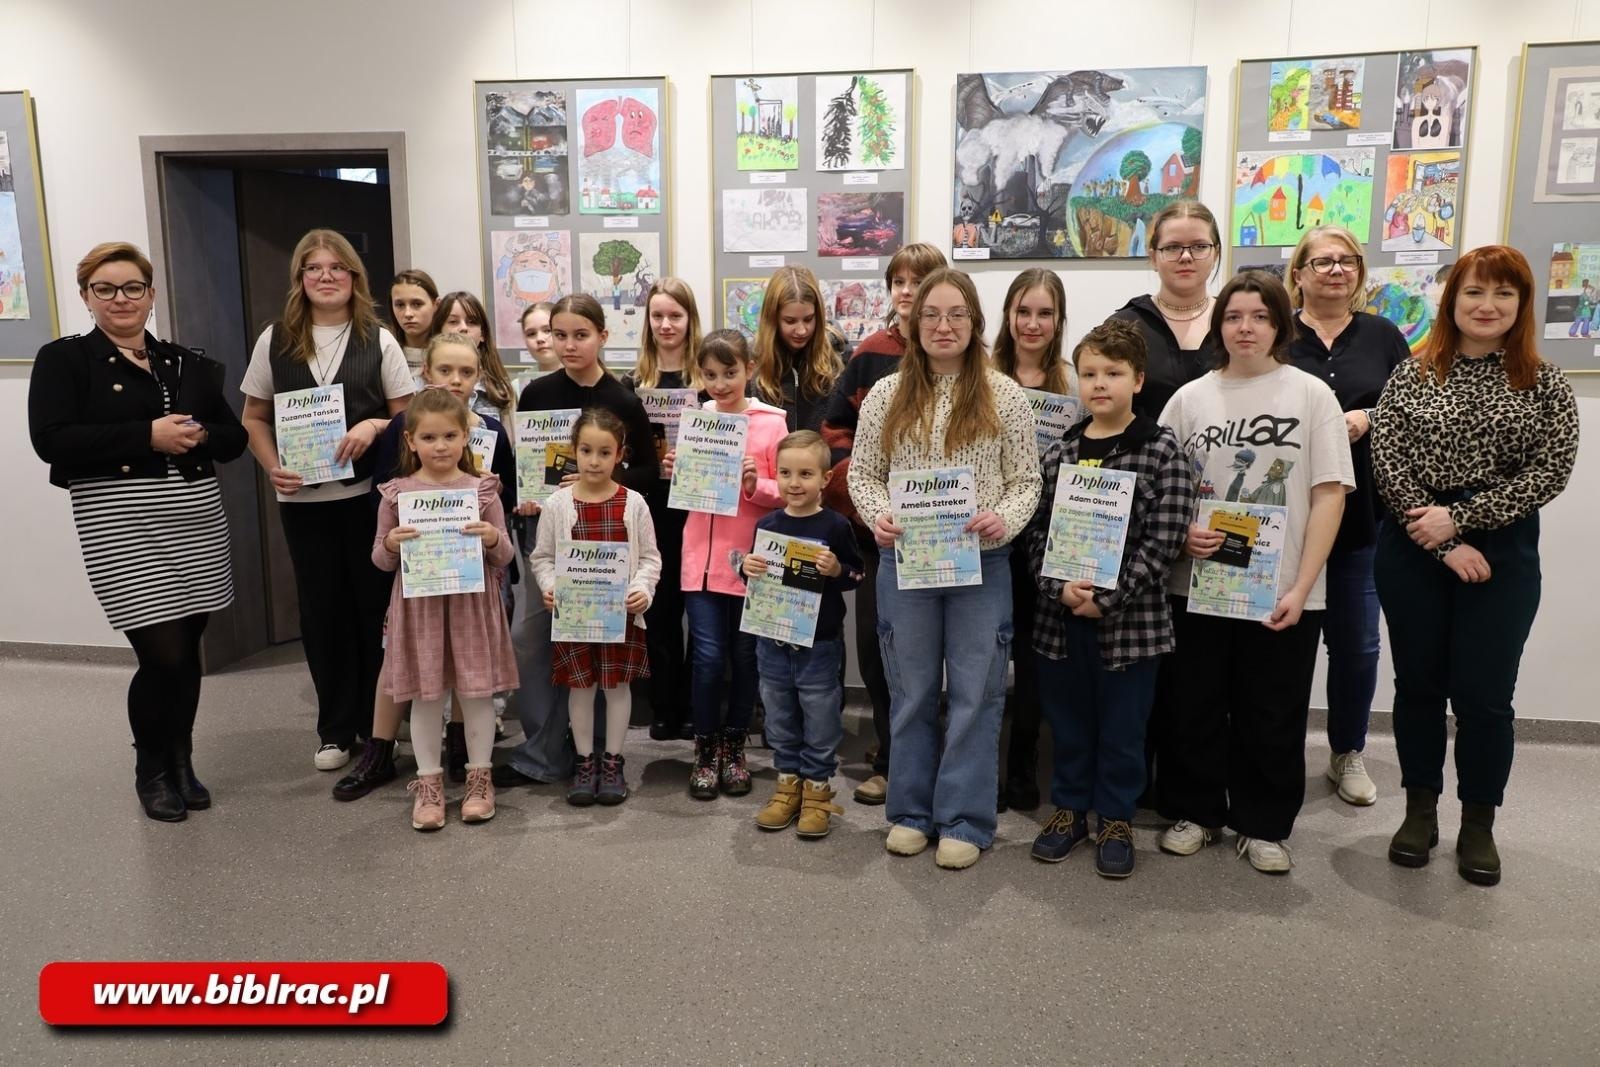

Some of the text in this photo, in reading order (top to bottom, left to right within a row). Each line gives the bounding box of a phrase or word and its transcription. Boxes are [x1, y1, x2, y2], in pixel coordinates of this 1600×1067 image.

[286, 395, 331, 408] Dyplom
[645, 395, 687, 407] Dyplom
[1029, 399, 1064, 414] plom
[281, 408, 340, 422] Zuzanna Tańska
[316, 419, 341, 427] miejsca
[526, 417, 570, 431] Dyplom
[691, 418, 736, 432] Dyplom
[1040, 419, 1067, 430] Nowak
[521, 434, 550, 443] Matylda
[704, 437, 739, 447] Kowalska
[904, 477, 959, 494] Dyplom
[1070, 474, 1121, 491] Dyplom
[413, 497, 464, 511] Dyplom
[901, 499, 967, 510] Amelia Sztreker
[1069, 494, 1118, 507] Adam Okrent
[940, 512, 970, 520] miejsca
[1095, 512, 1123, 522] miejsca
[568, 548, 618, 561] Dyplom
[766, 560, 786, 569] akub
